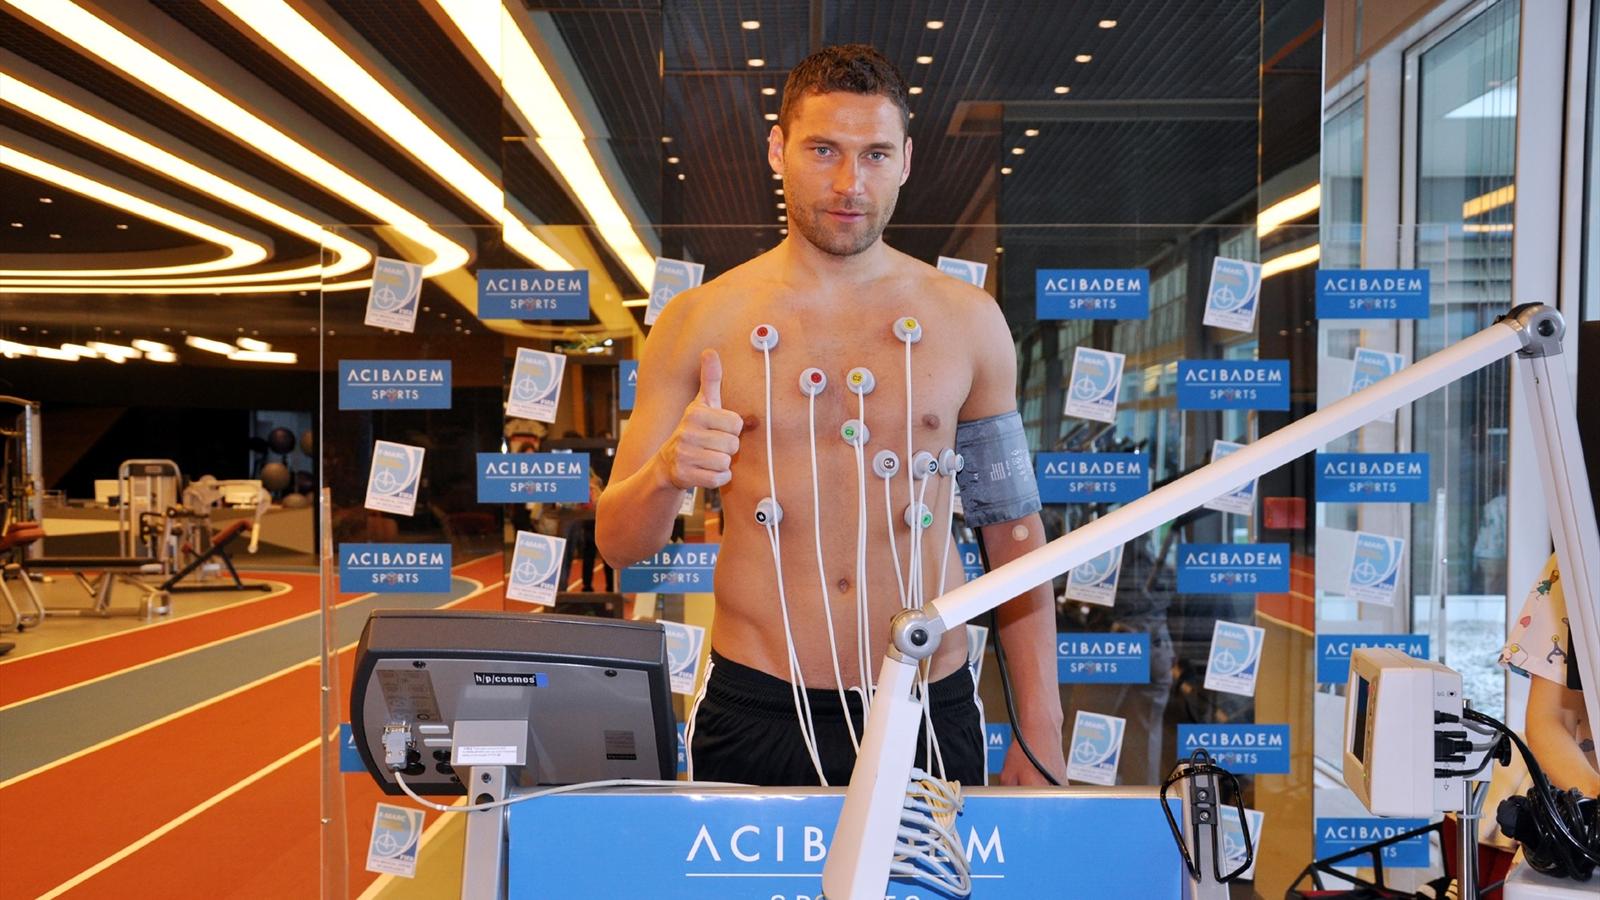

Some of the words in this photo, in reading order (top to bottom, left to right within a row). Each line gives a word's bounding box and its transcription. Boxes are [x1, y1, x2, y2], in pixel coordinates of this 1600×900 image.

[485, 279, 582, 291] ACIBADEM
[1044, 279, 1141, 291] ACIBADEM
[1324, 279, 1422, 291] ACIBADEM
[347, 369, 444, 381] ACIBADEM
[1185, 369, 1282, 381] ACIBADEM
[485, 462, 582, 474] ACIBADEM
[1044, 462, 1141, 474] ACIBADEM
[1324, 462, 1422, 474] ACIBADEM
[347, 553, 444, 565] ACIBADEM
[636, 553, 718, 565] IBADE
[1185, 553, 1282, 565] ACIBADEM
[1058, 642, 1142, 655] CIBADEM
[1185, 733, 1282, 745] ACIBADEM
[686, 824, 1005, 863] ACIBM
